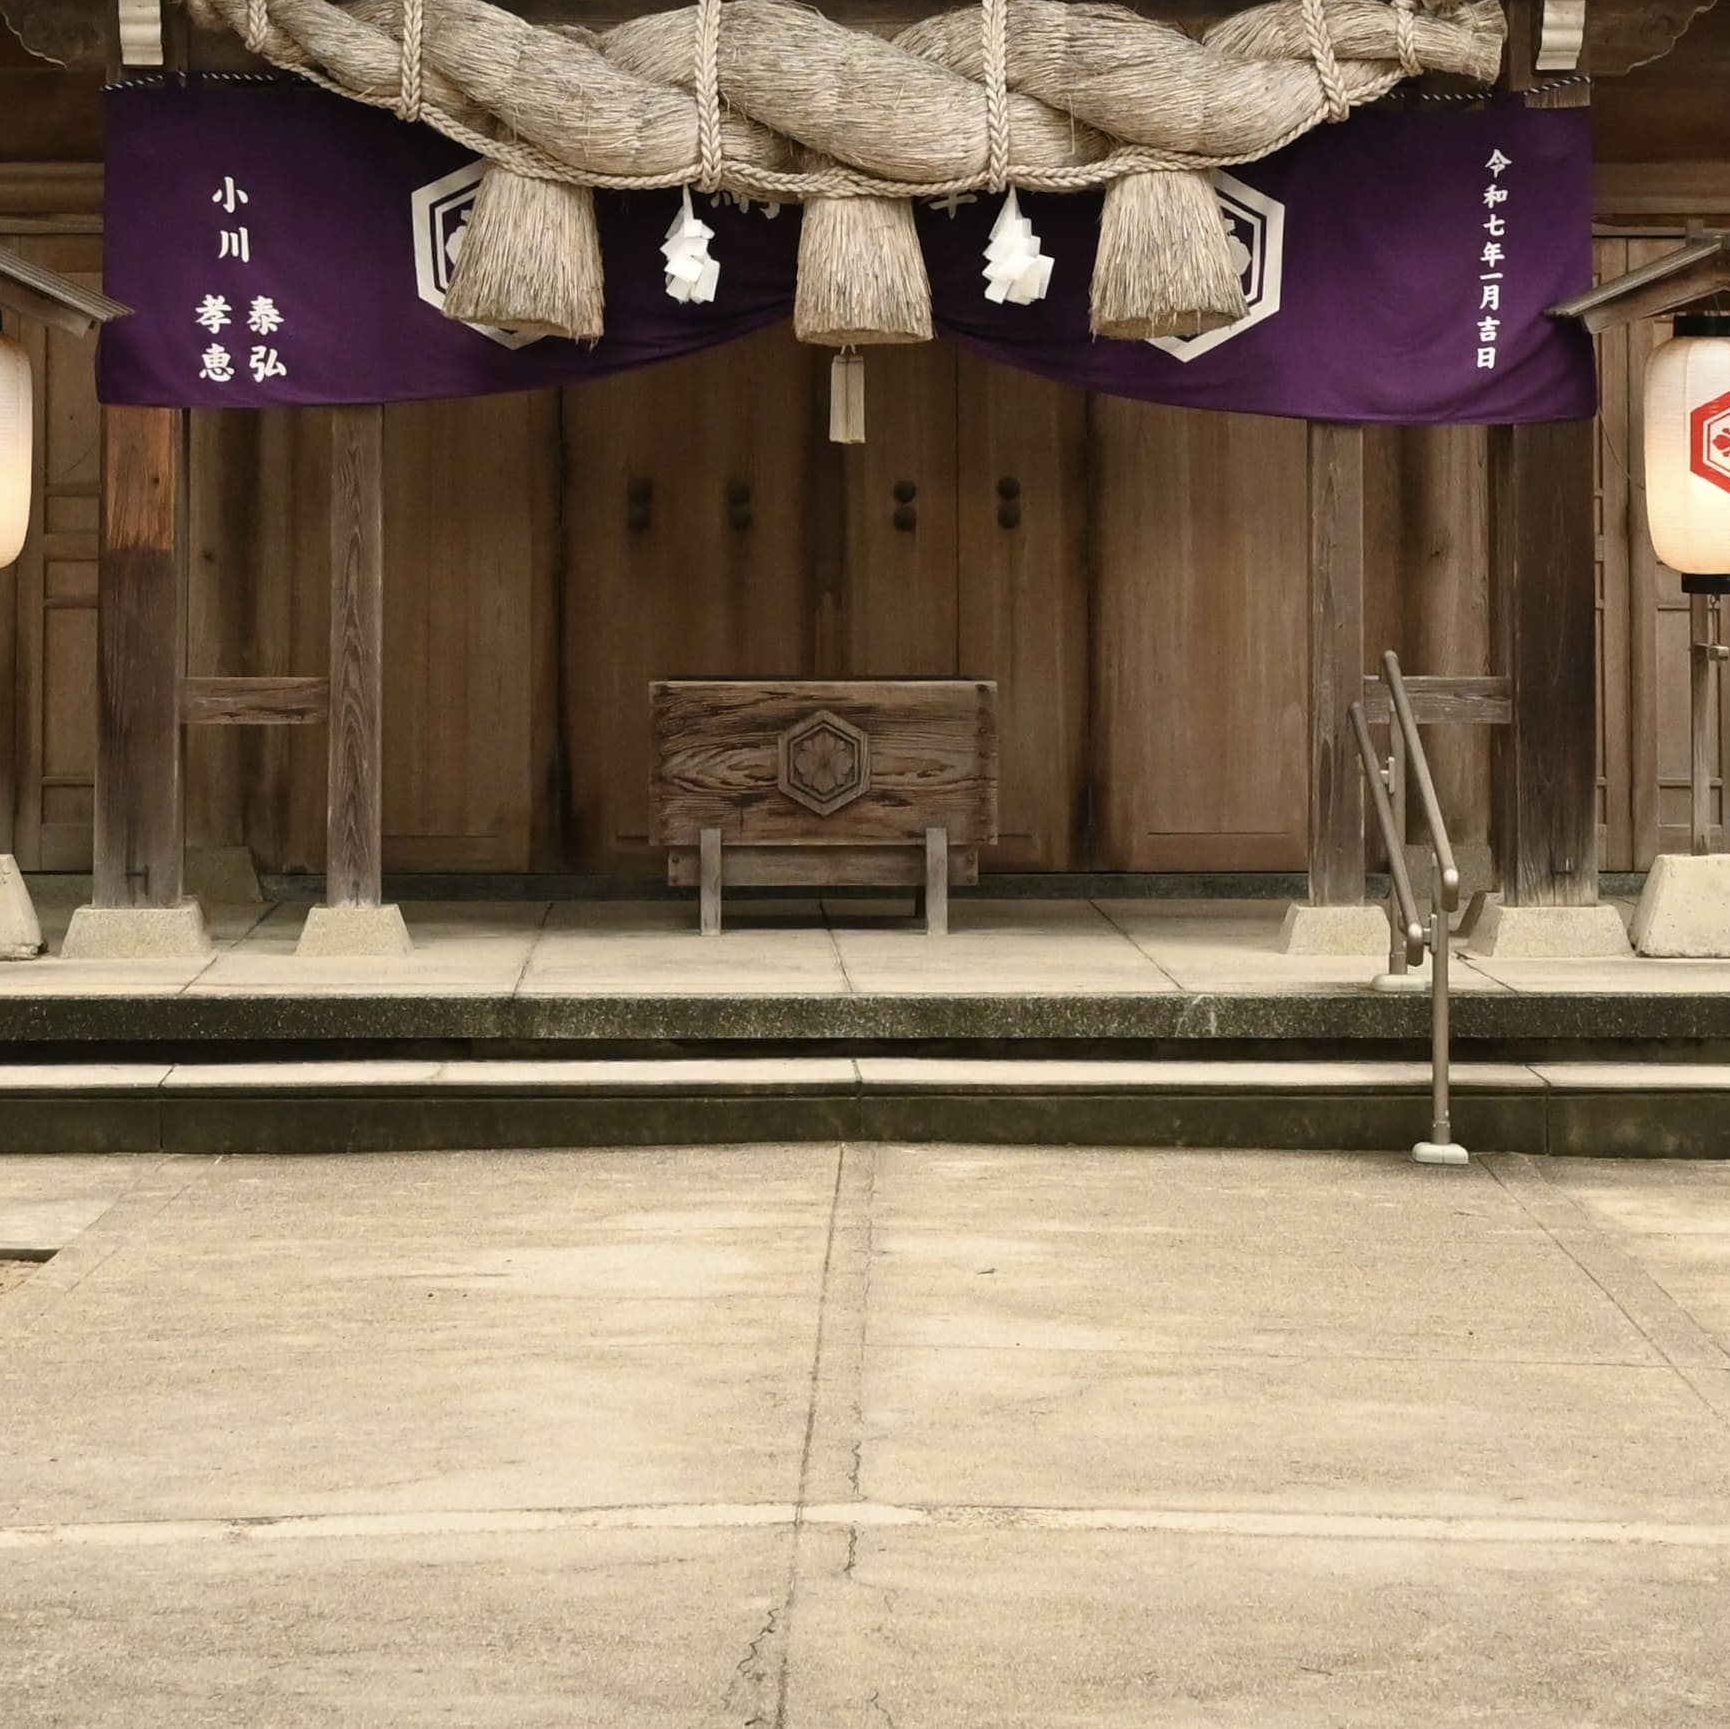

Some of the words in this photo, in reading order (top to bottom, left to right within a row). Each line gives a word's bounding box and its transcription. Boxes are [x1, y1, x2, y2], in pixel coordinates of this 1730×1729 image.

[212, 176, 250, 263] 小川
[1476, 148, 1513, 370] 令和七年一月吉日
[195, 293, 235, 383] 孝恵
[247, 295, 287, 383] 泰弘
